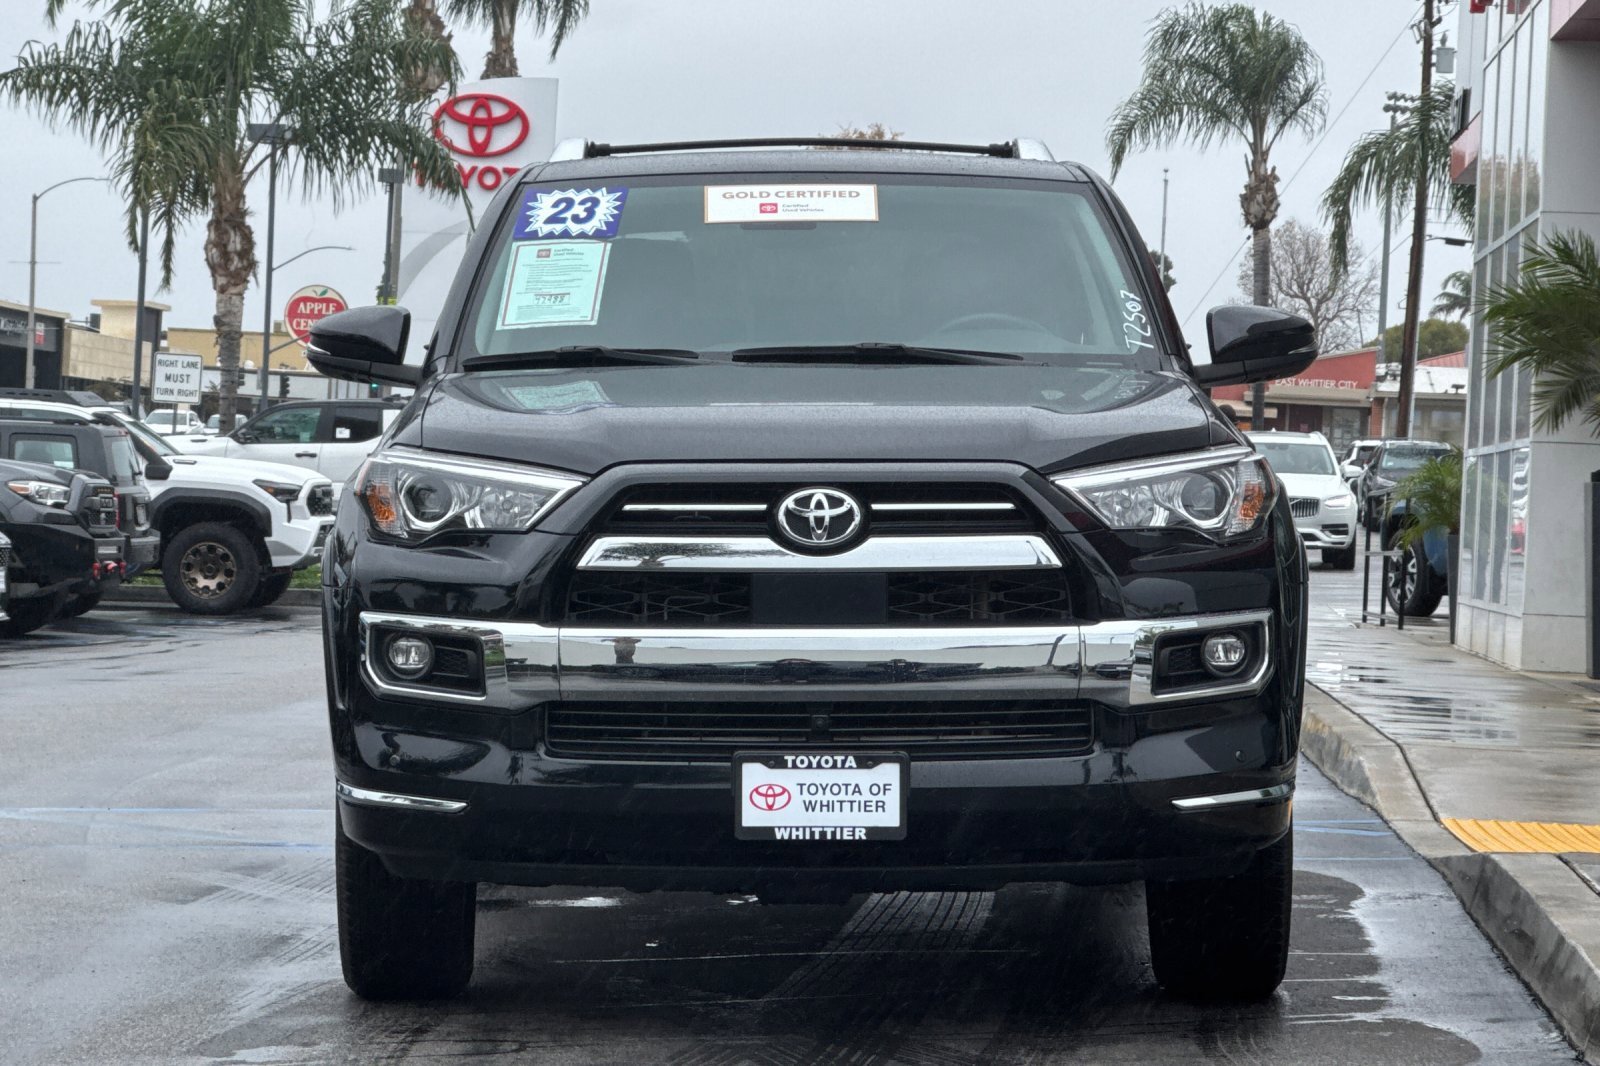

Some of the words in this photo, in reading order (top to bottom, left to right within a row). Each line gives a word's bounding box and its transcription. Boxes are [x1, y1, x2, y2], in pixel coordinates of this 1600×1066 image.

[722, 190, 771, 200] GOLD
[774, 189, 861, 199] CERTIFIED
[542, 196, 601, 226] 23
[297, 301, 337, 315] APPLE
[157, 358, 179, 368] RIGHT
[181, 360, 200, 370] LANE
[165, 373, 191, 384] MUST
[1274, 377, 1297, 386] EAST
[1297, 378, 1336, 389] WHITTIER
[1337, 379, 1359, 389] CITY
[156, 387, 175, 396] TURN
[177, 388, 198, 398] RIGHT
[784, 755, 858, 769] TOYOTA
[796, 783, 863, 796] TOYOTA
[868, 783, 893, 796] OF
[803, 800, 886, 813] WHITTIER
[774, 827, 867, 840] WHITTIER
